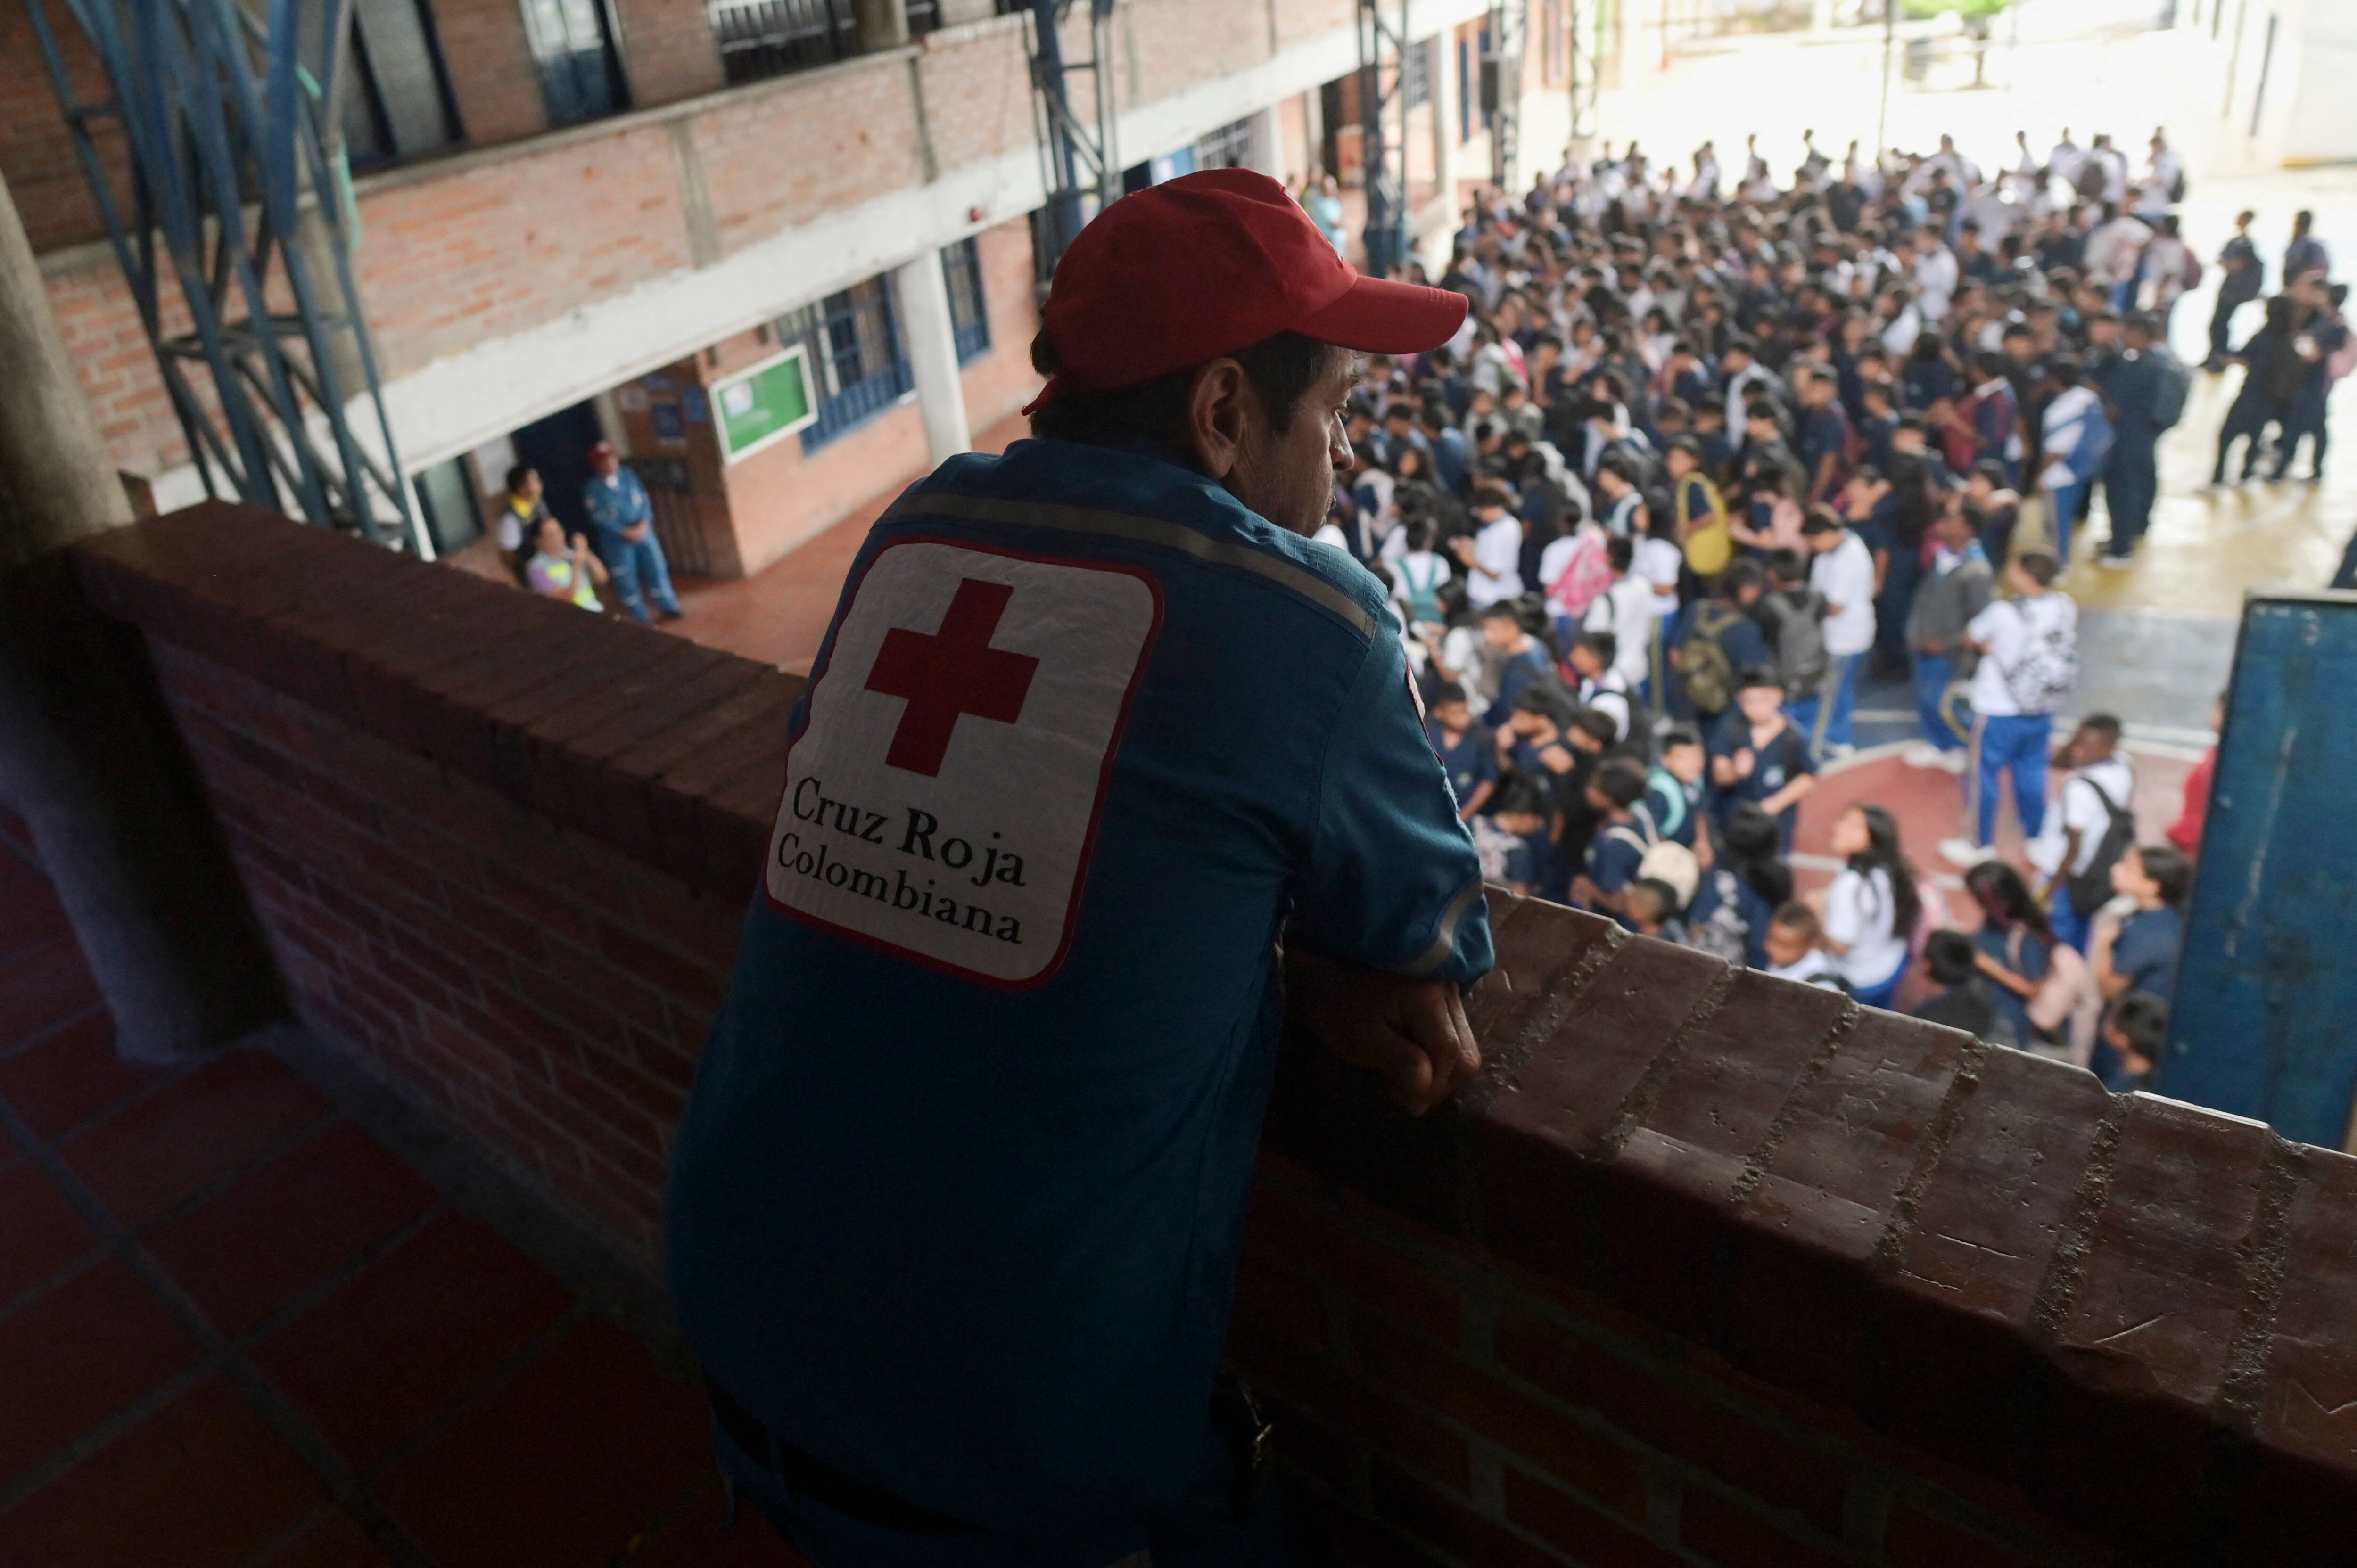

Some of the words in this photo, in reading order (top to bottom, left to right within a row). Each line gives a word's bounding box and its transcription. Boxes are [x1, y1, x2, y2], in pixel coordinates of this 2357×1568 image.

[793, 776, 888, 845] Cruz
[897, 807, 1026, 887] Roja
[778, 832, 1022, 944] Colombiana
